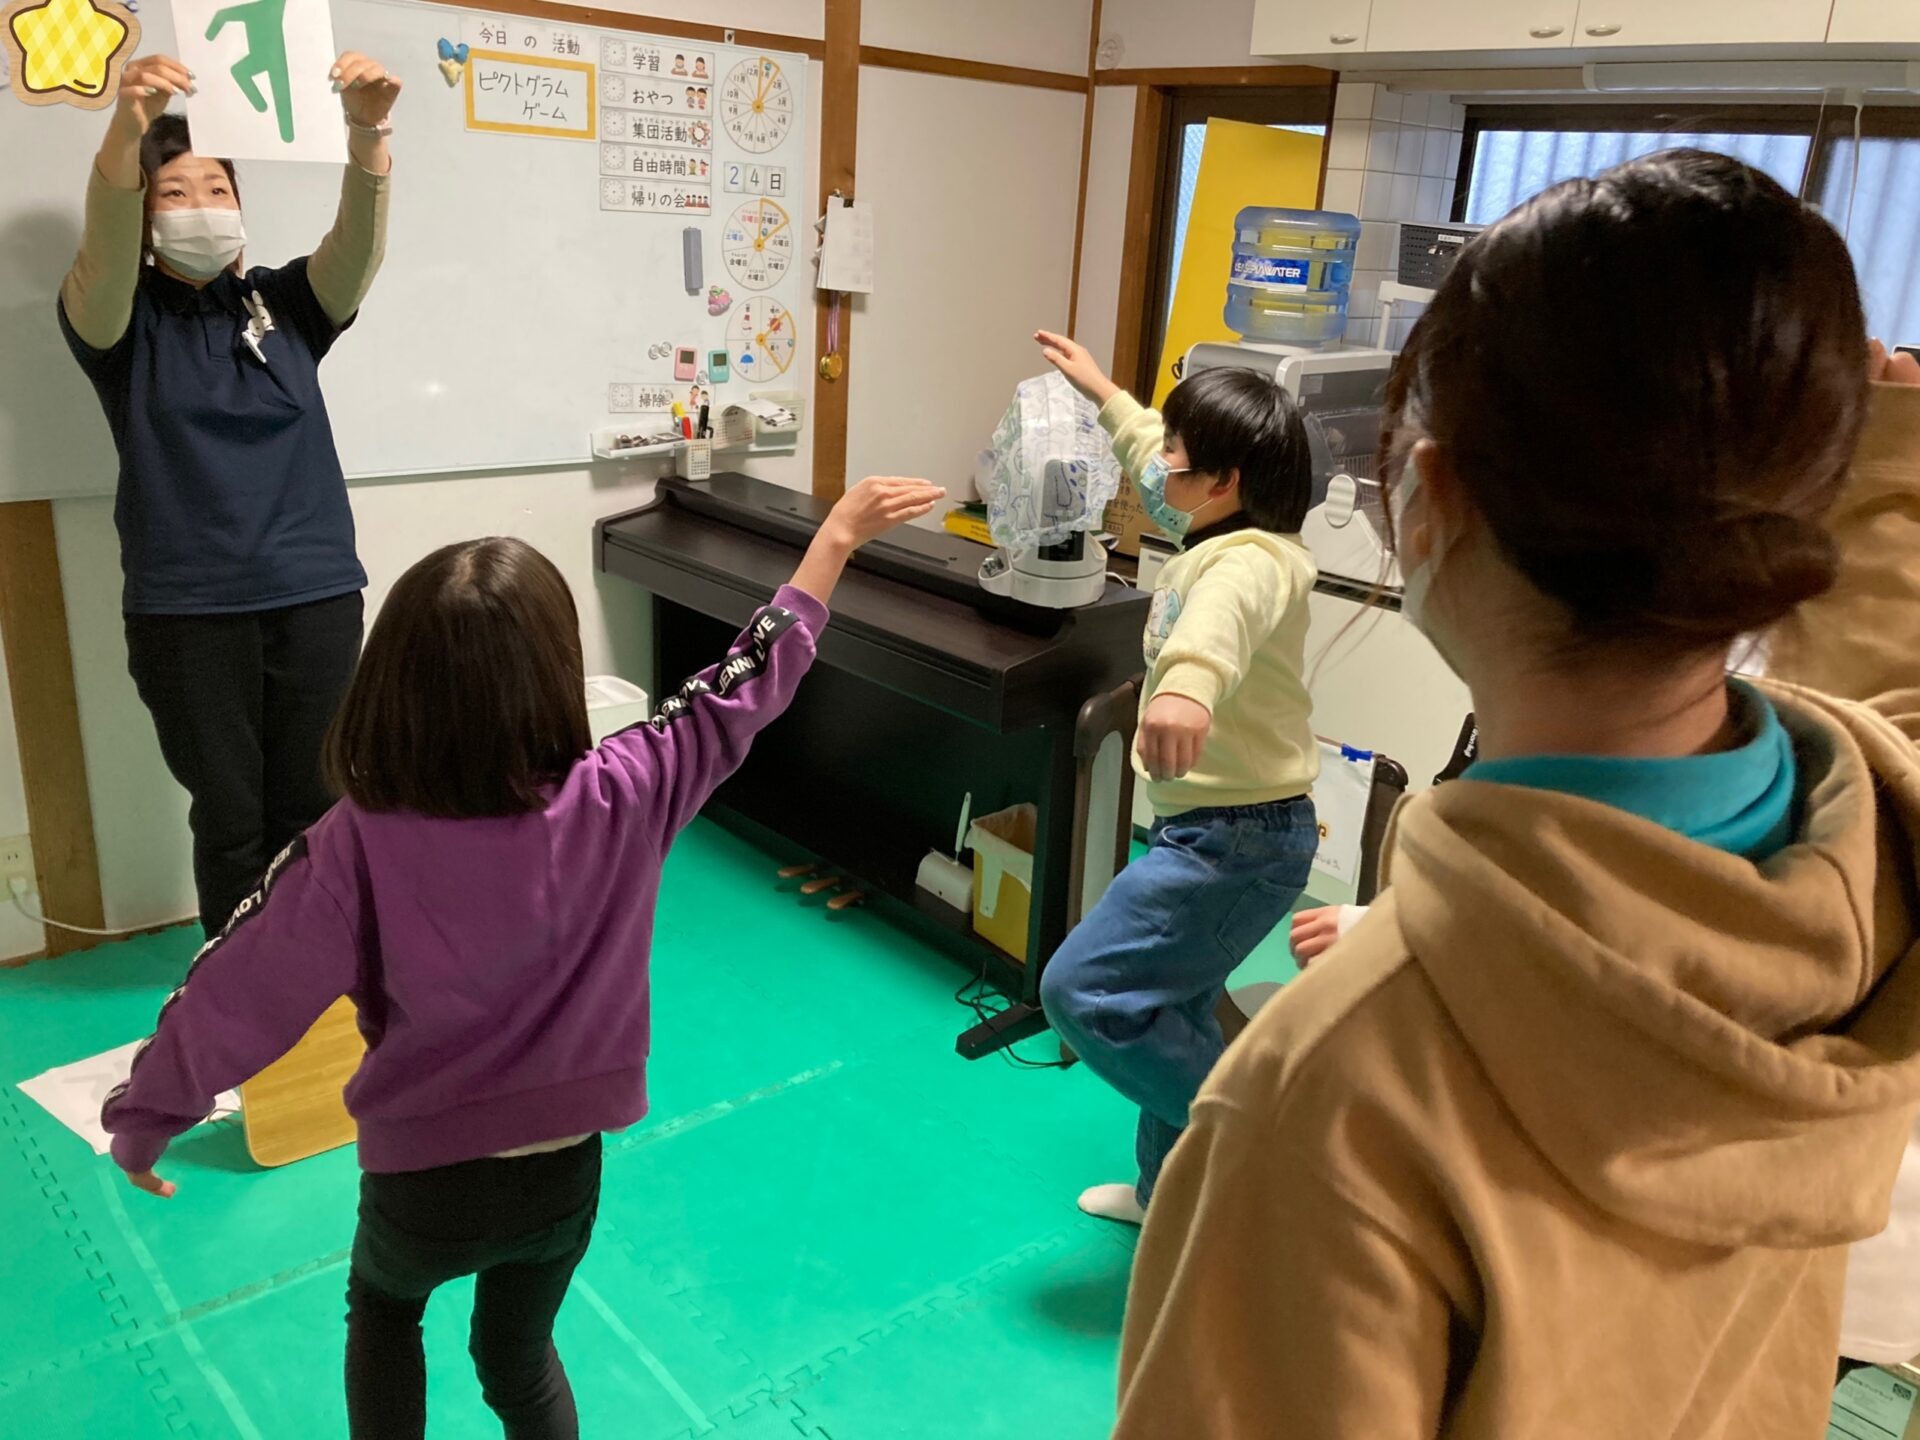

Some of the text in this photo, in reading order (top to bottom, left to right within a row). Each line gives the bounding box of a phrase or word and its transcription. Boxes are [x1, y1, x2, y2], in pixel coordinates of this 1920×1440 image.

[479, 27, 580, 55] 今日 の 活動
[633, 53, 661, 72] 学習
[479, 71, 569, 98] ピクトグラム
[632, 89, 673, 105] おやつ
[522, 100, 568, 121] ゲーム
[632, 122, 688, 143] 集団活動
[633, 157, 686, 176] 自由時間
[631, 189, 686, 209] 帰りの会
[639, 393, 666, 408] 掃除
[719, 656, 756, 695] JENNI
